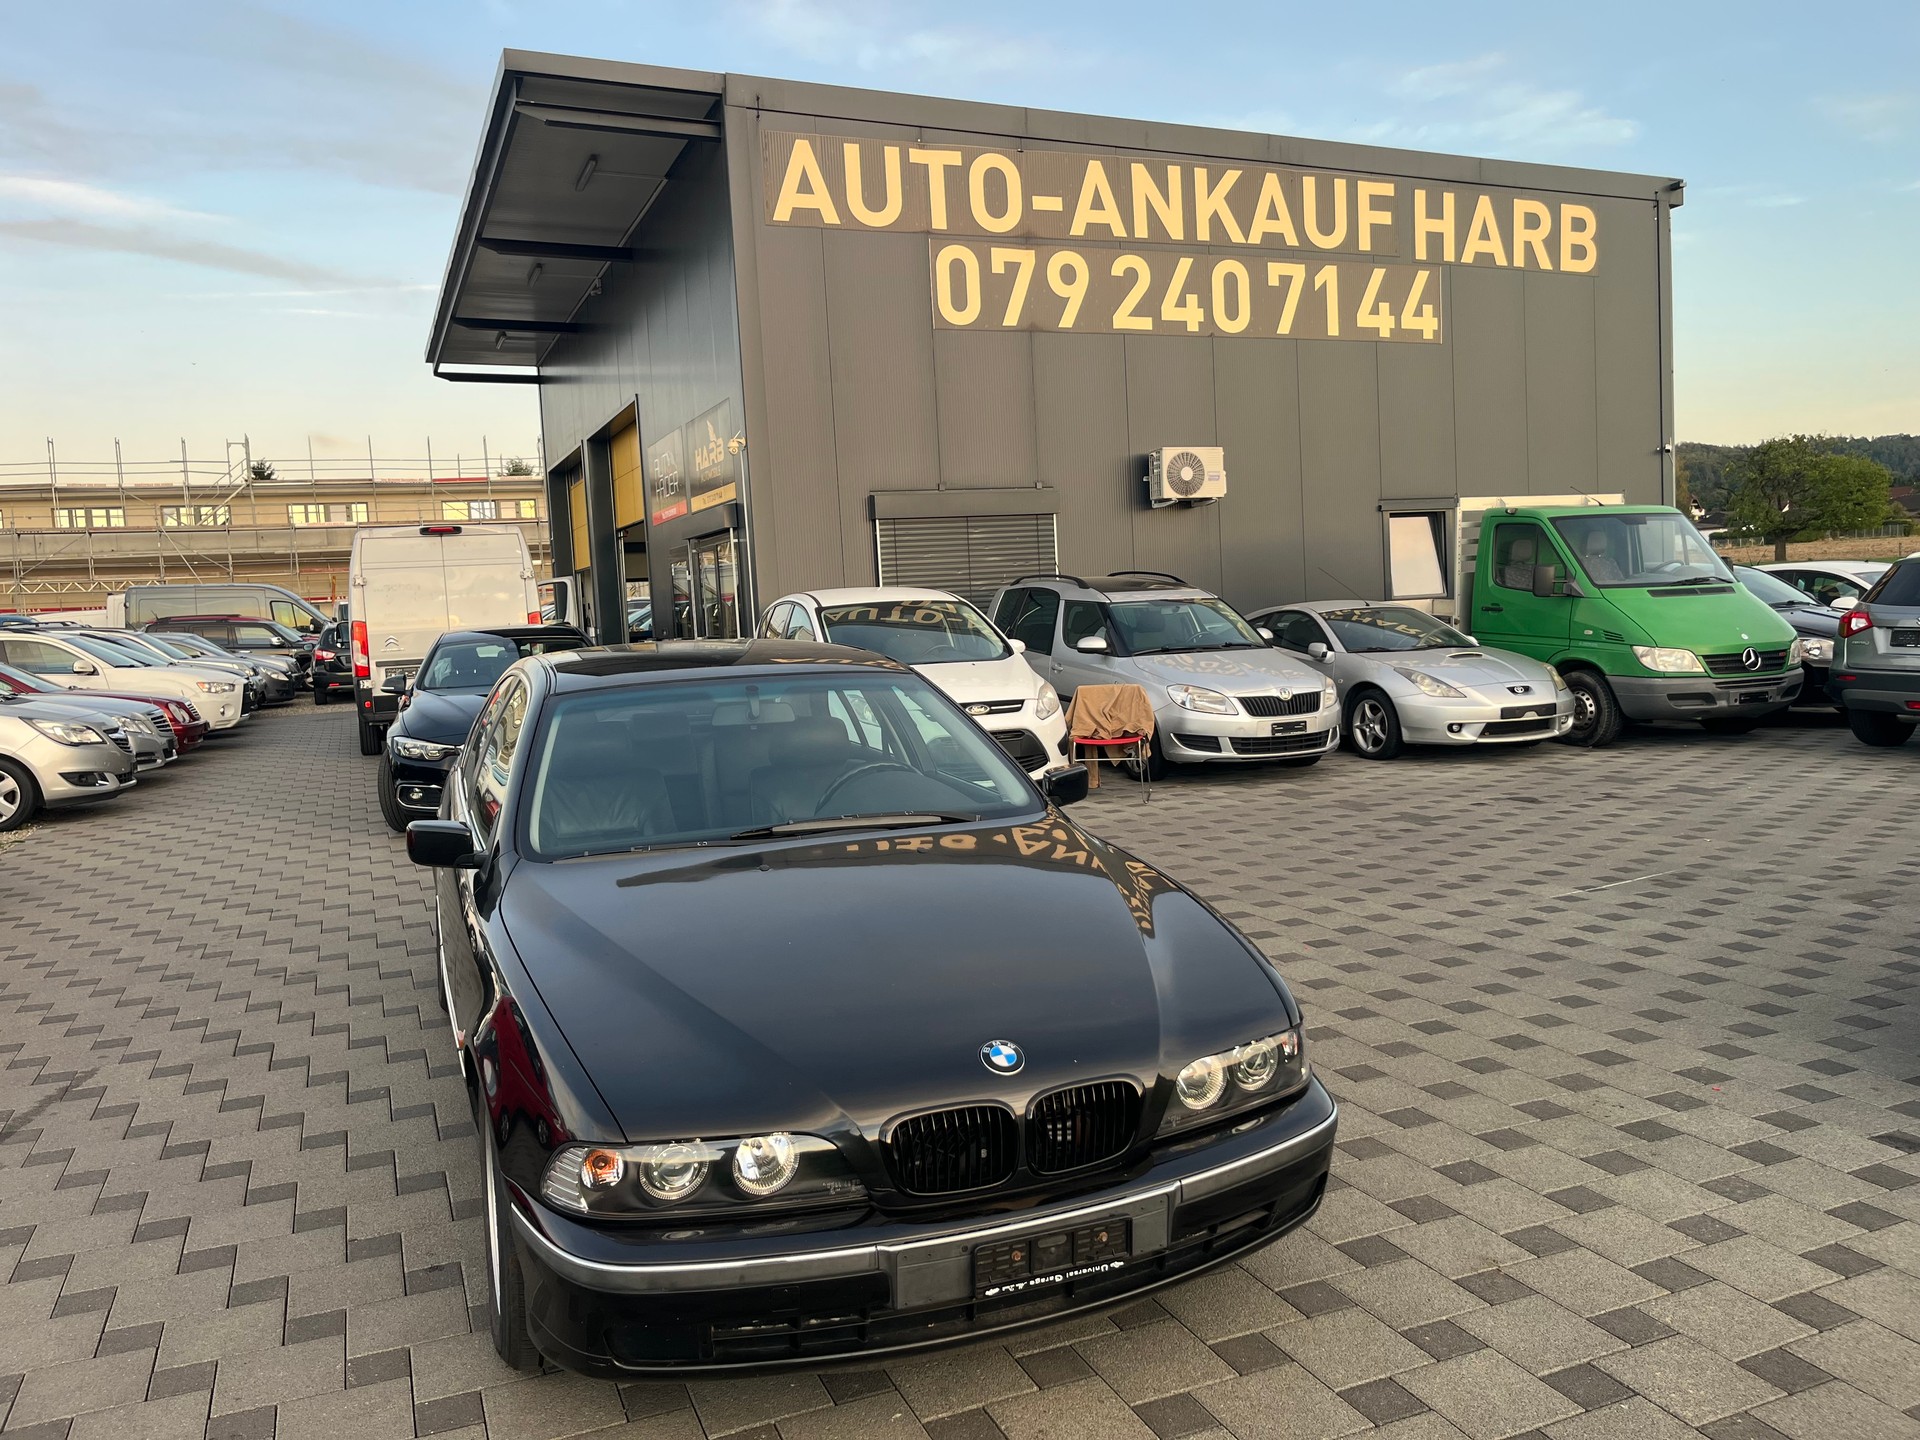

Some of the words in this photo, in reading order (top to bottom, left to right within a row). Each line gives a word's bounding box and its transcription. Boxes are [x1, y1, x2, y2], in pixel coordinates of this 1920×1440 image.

[773, 139, 1395, 252] AUTO-ANKAUF
[1415, 189, 1597, 273] HARB
[936, 244, 1090, 328] 079
[1111, 254, 1251, 334] 240
[1268, 262, 1341, 337] 71
[1357, 267, 1440, 341] 44
[694, 437, 725, 472] HARB
[1029, 1274, 1064, 1287] Garage
[1066, 1264, 1109, 1279] Universal
